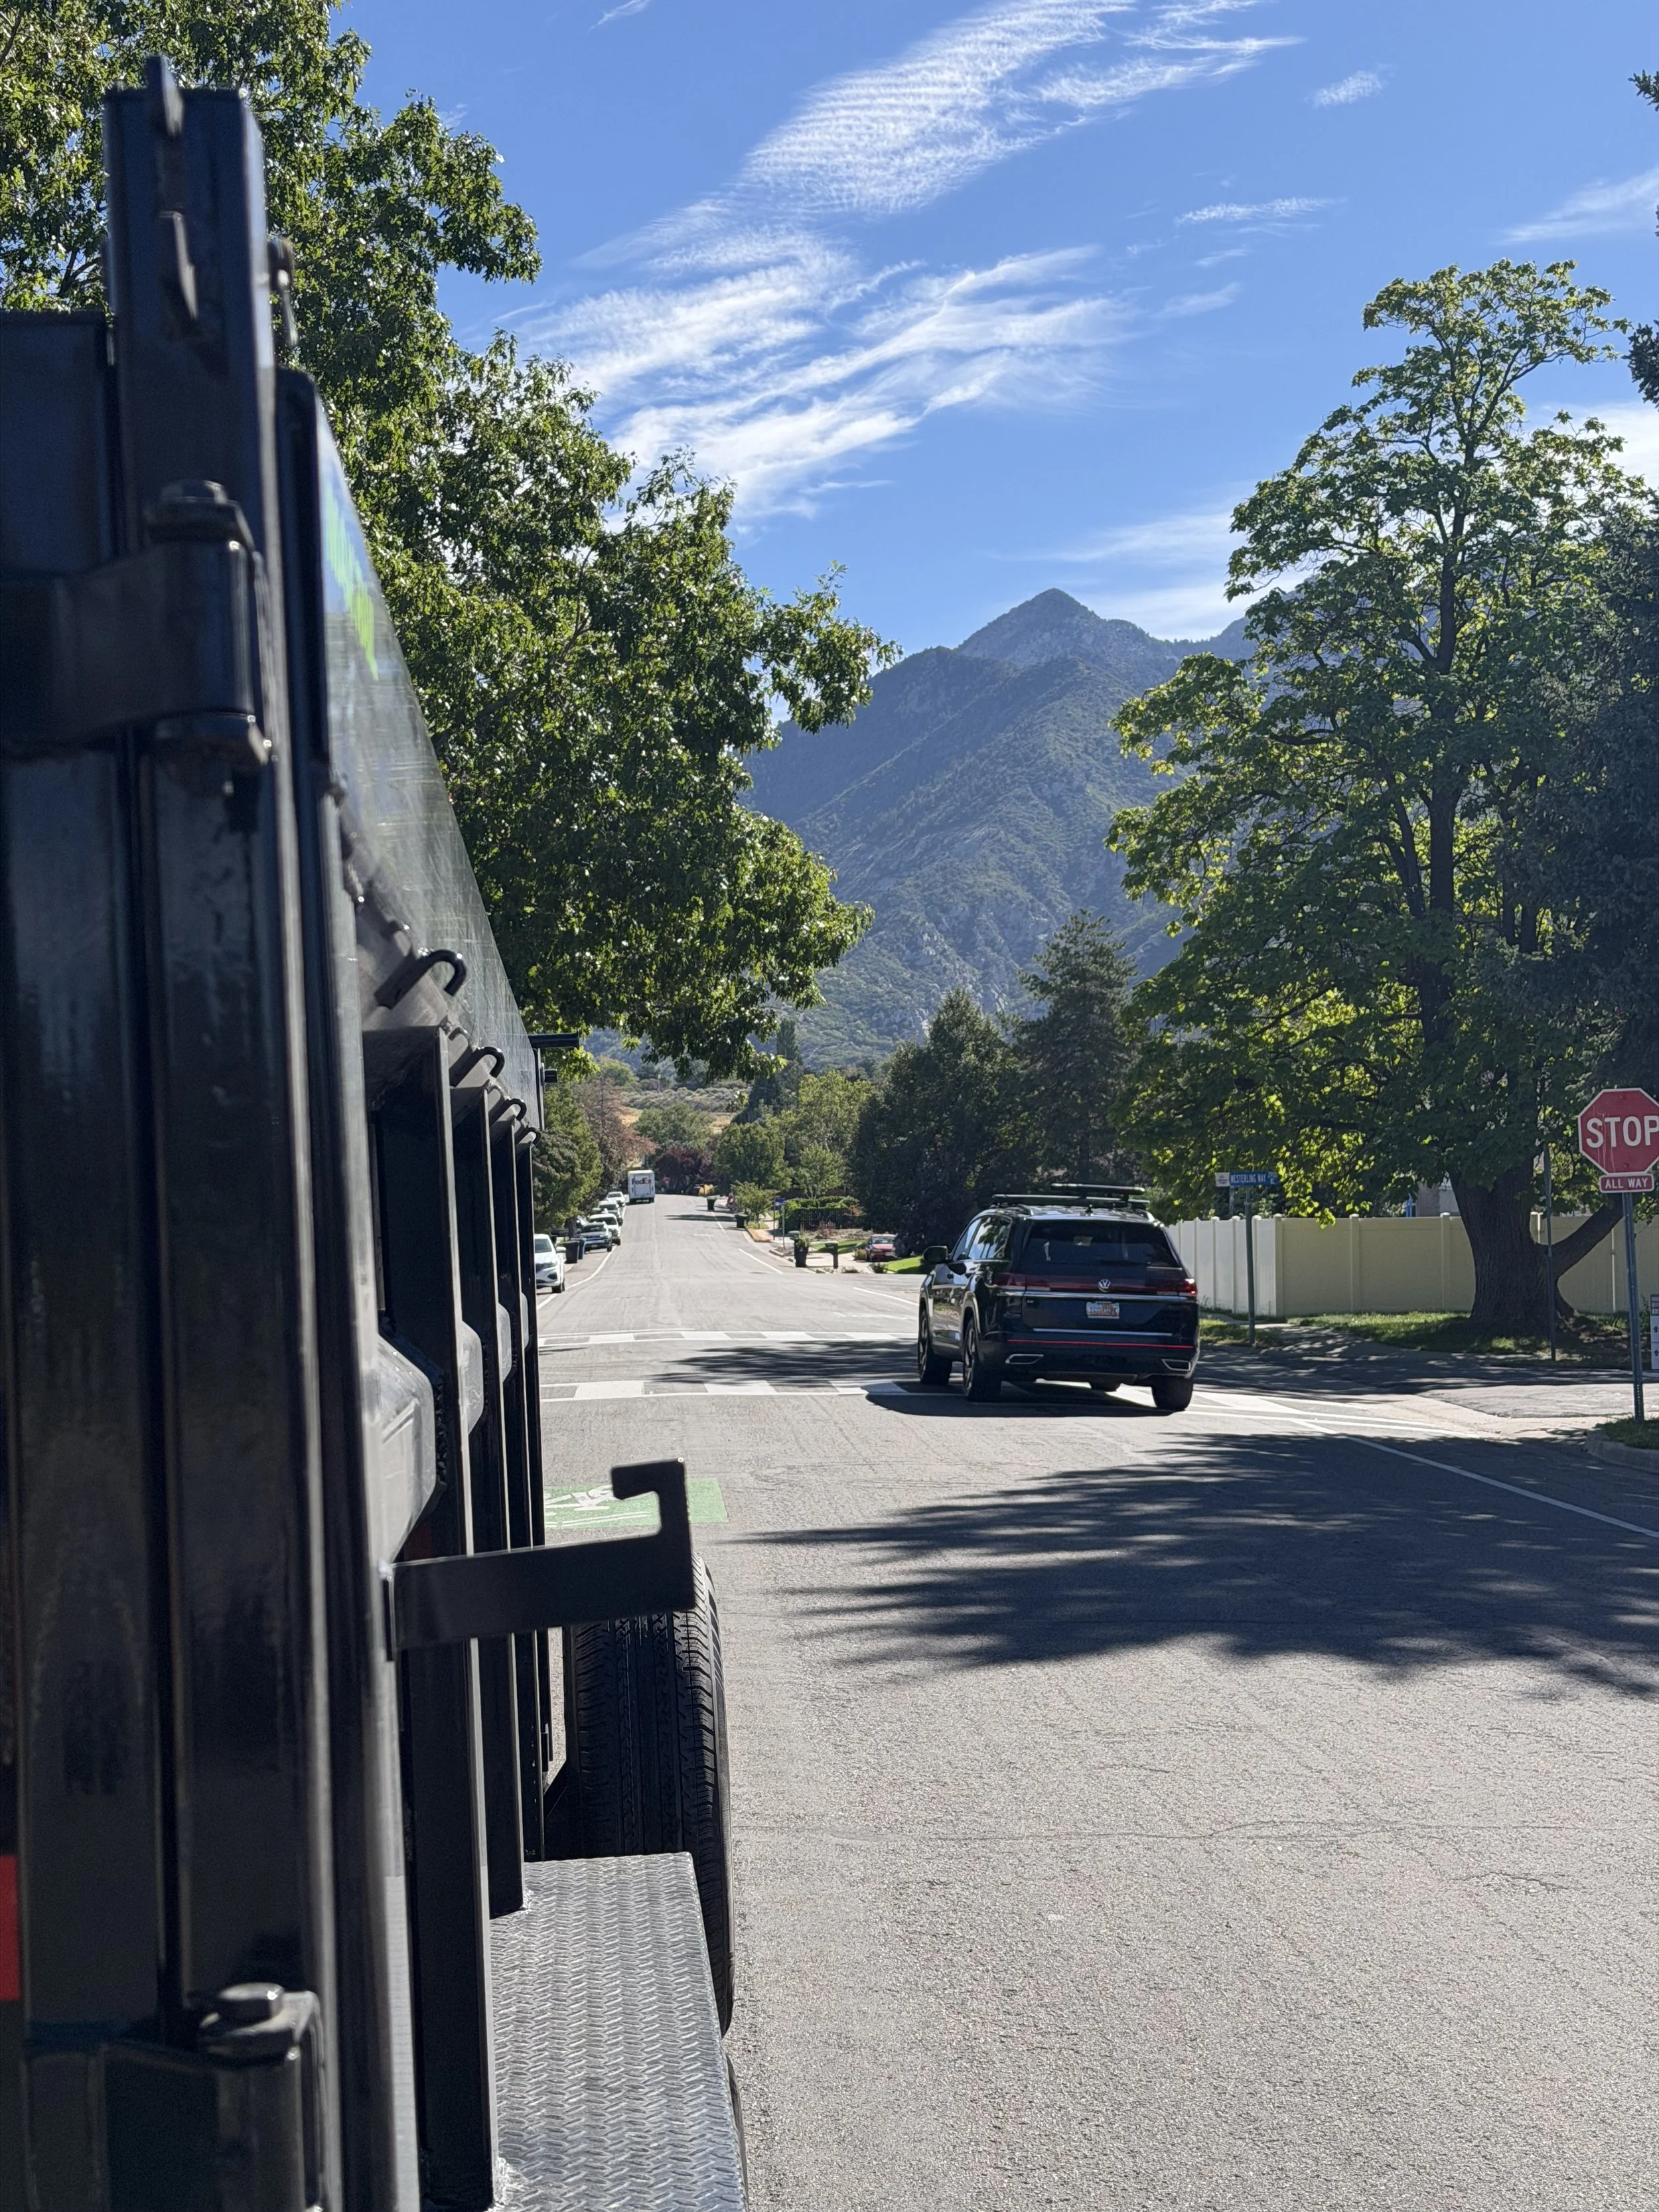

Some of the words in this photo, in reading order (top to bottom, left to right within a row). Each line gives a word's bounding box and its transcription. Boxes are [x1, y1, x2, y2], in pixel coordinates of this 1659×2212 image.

[1587, 1116, 1659, 1148] STOP
[1605, 1179, 1624, 1189] ALL
[1628, 1178, 1648, 1188] WAY
